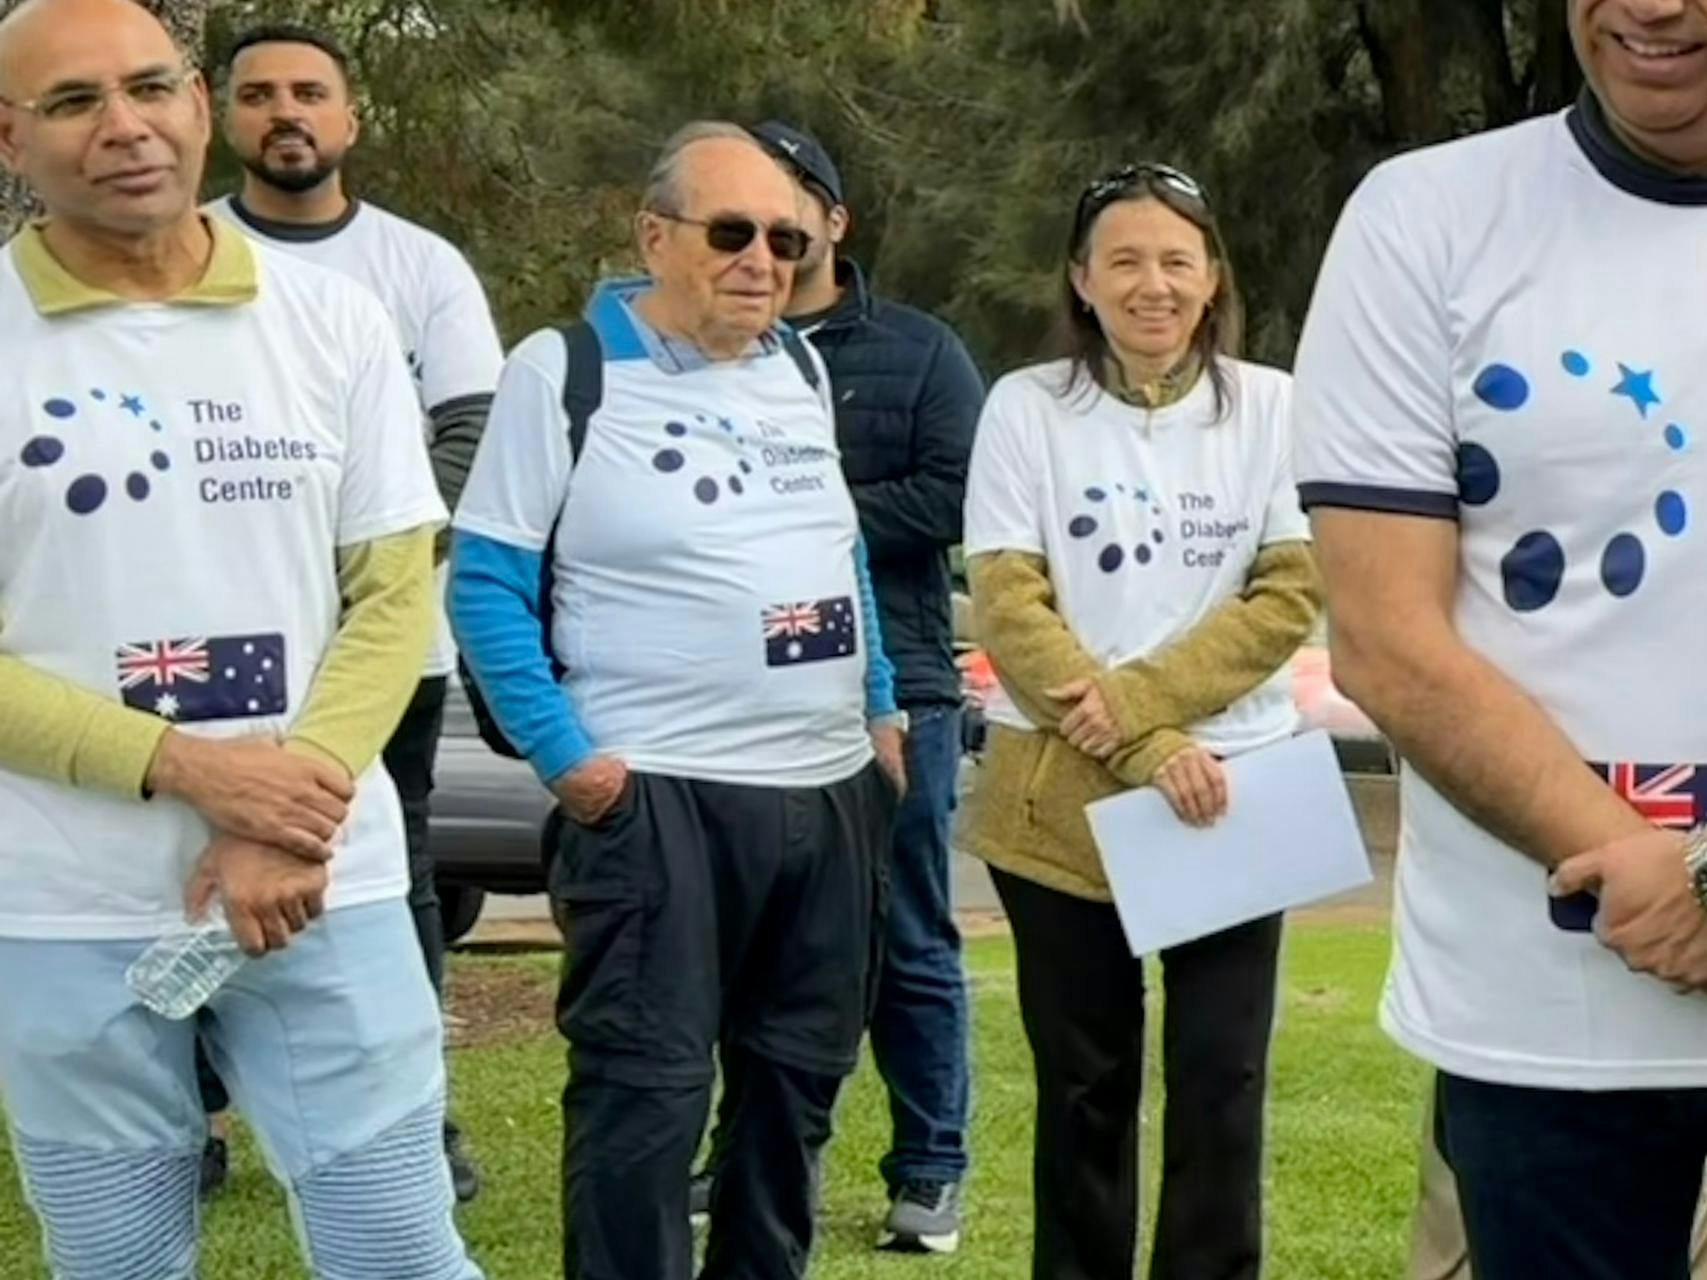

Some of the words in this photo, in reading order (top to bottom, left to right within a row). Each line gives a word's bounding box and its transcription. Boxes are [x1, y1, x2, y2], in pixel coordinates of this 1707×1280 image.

[187, 399, 243, 423] The
[194, 435, 318, 464] Diabetes
[1178, 492, 1215, 511] The
